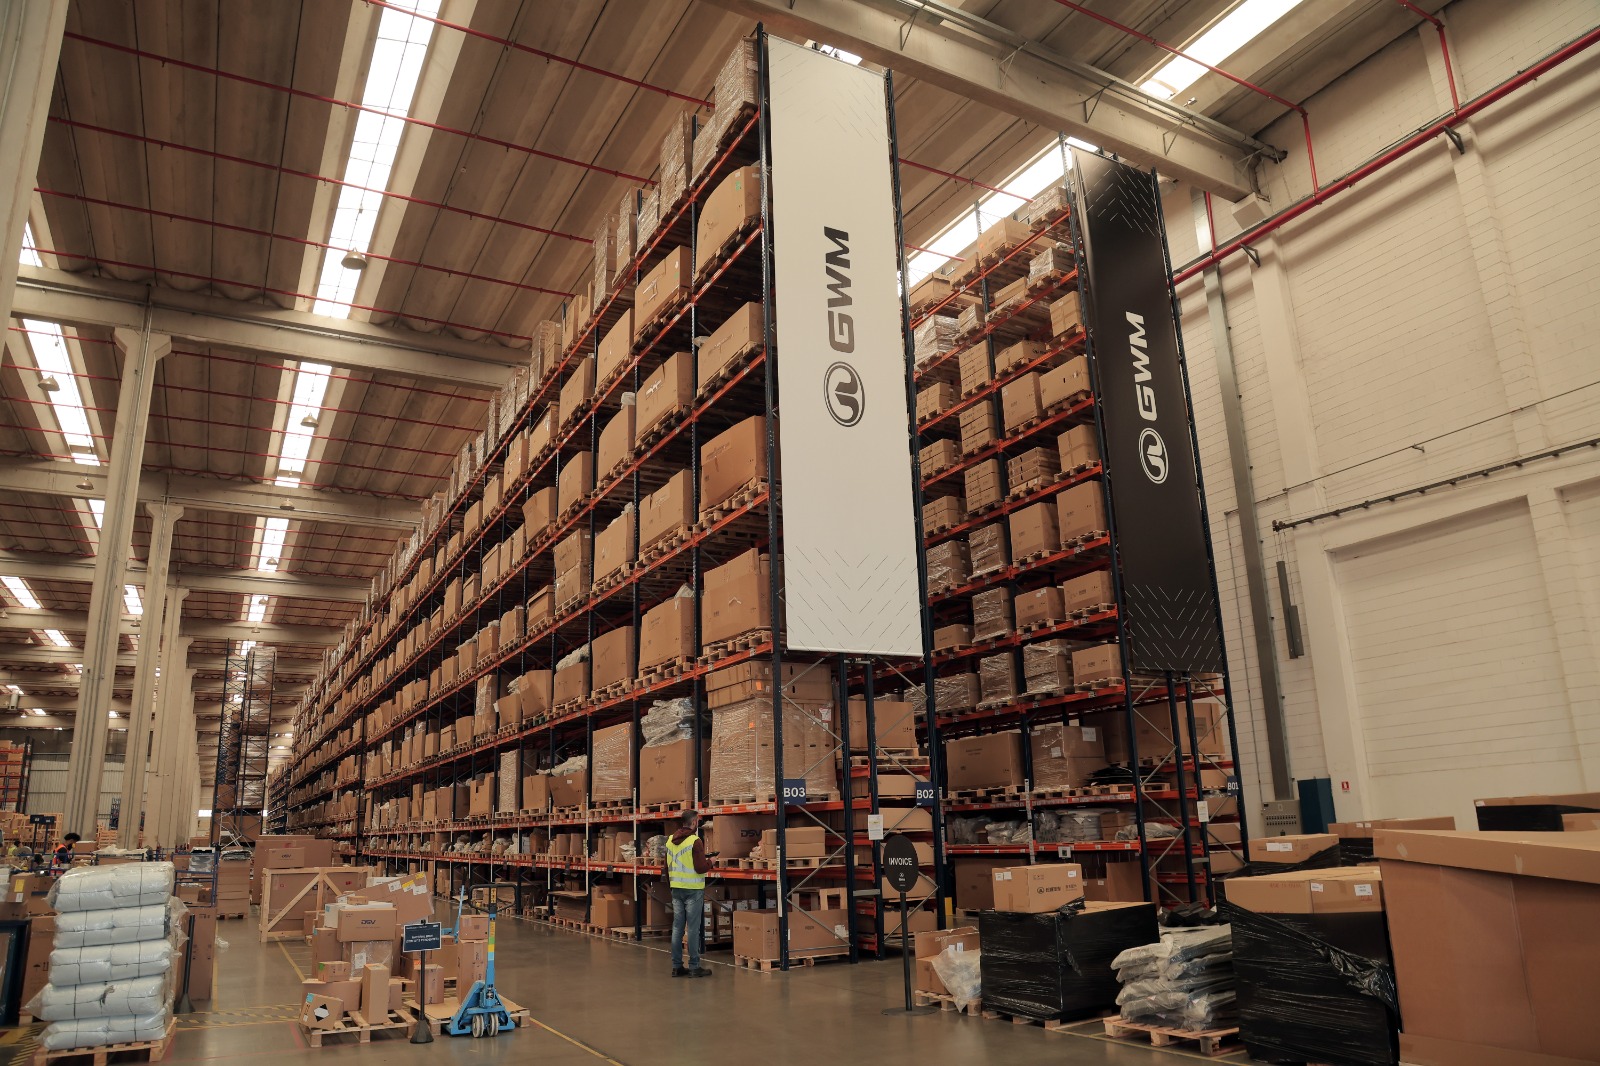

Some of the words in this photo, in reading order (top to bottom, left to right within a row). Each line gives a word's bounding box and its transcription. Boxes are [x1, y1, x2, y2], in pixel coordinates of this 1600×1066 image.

[823, 225, 855, 354] GWM
[1125, 311, 1158, 422] GWM
[1227, 781, 1239, 790] B01
[783, 787, 806, 798] B03
[916, 789, 934, 799] B02
[740, 829, 762, 838] DSV
[888, 857, 913, 866] INVOICE
